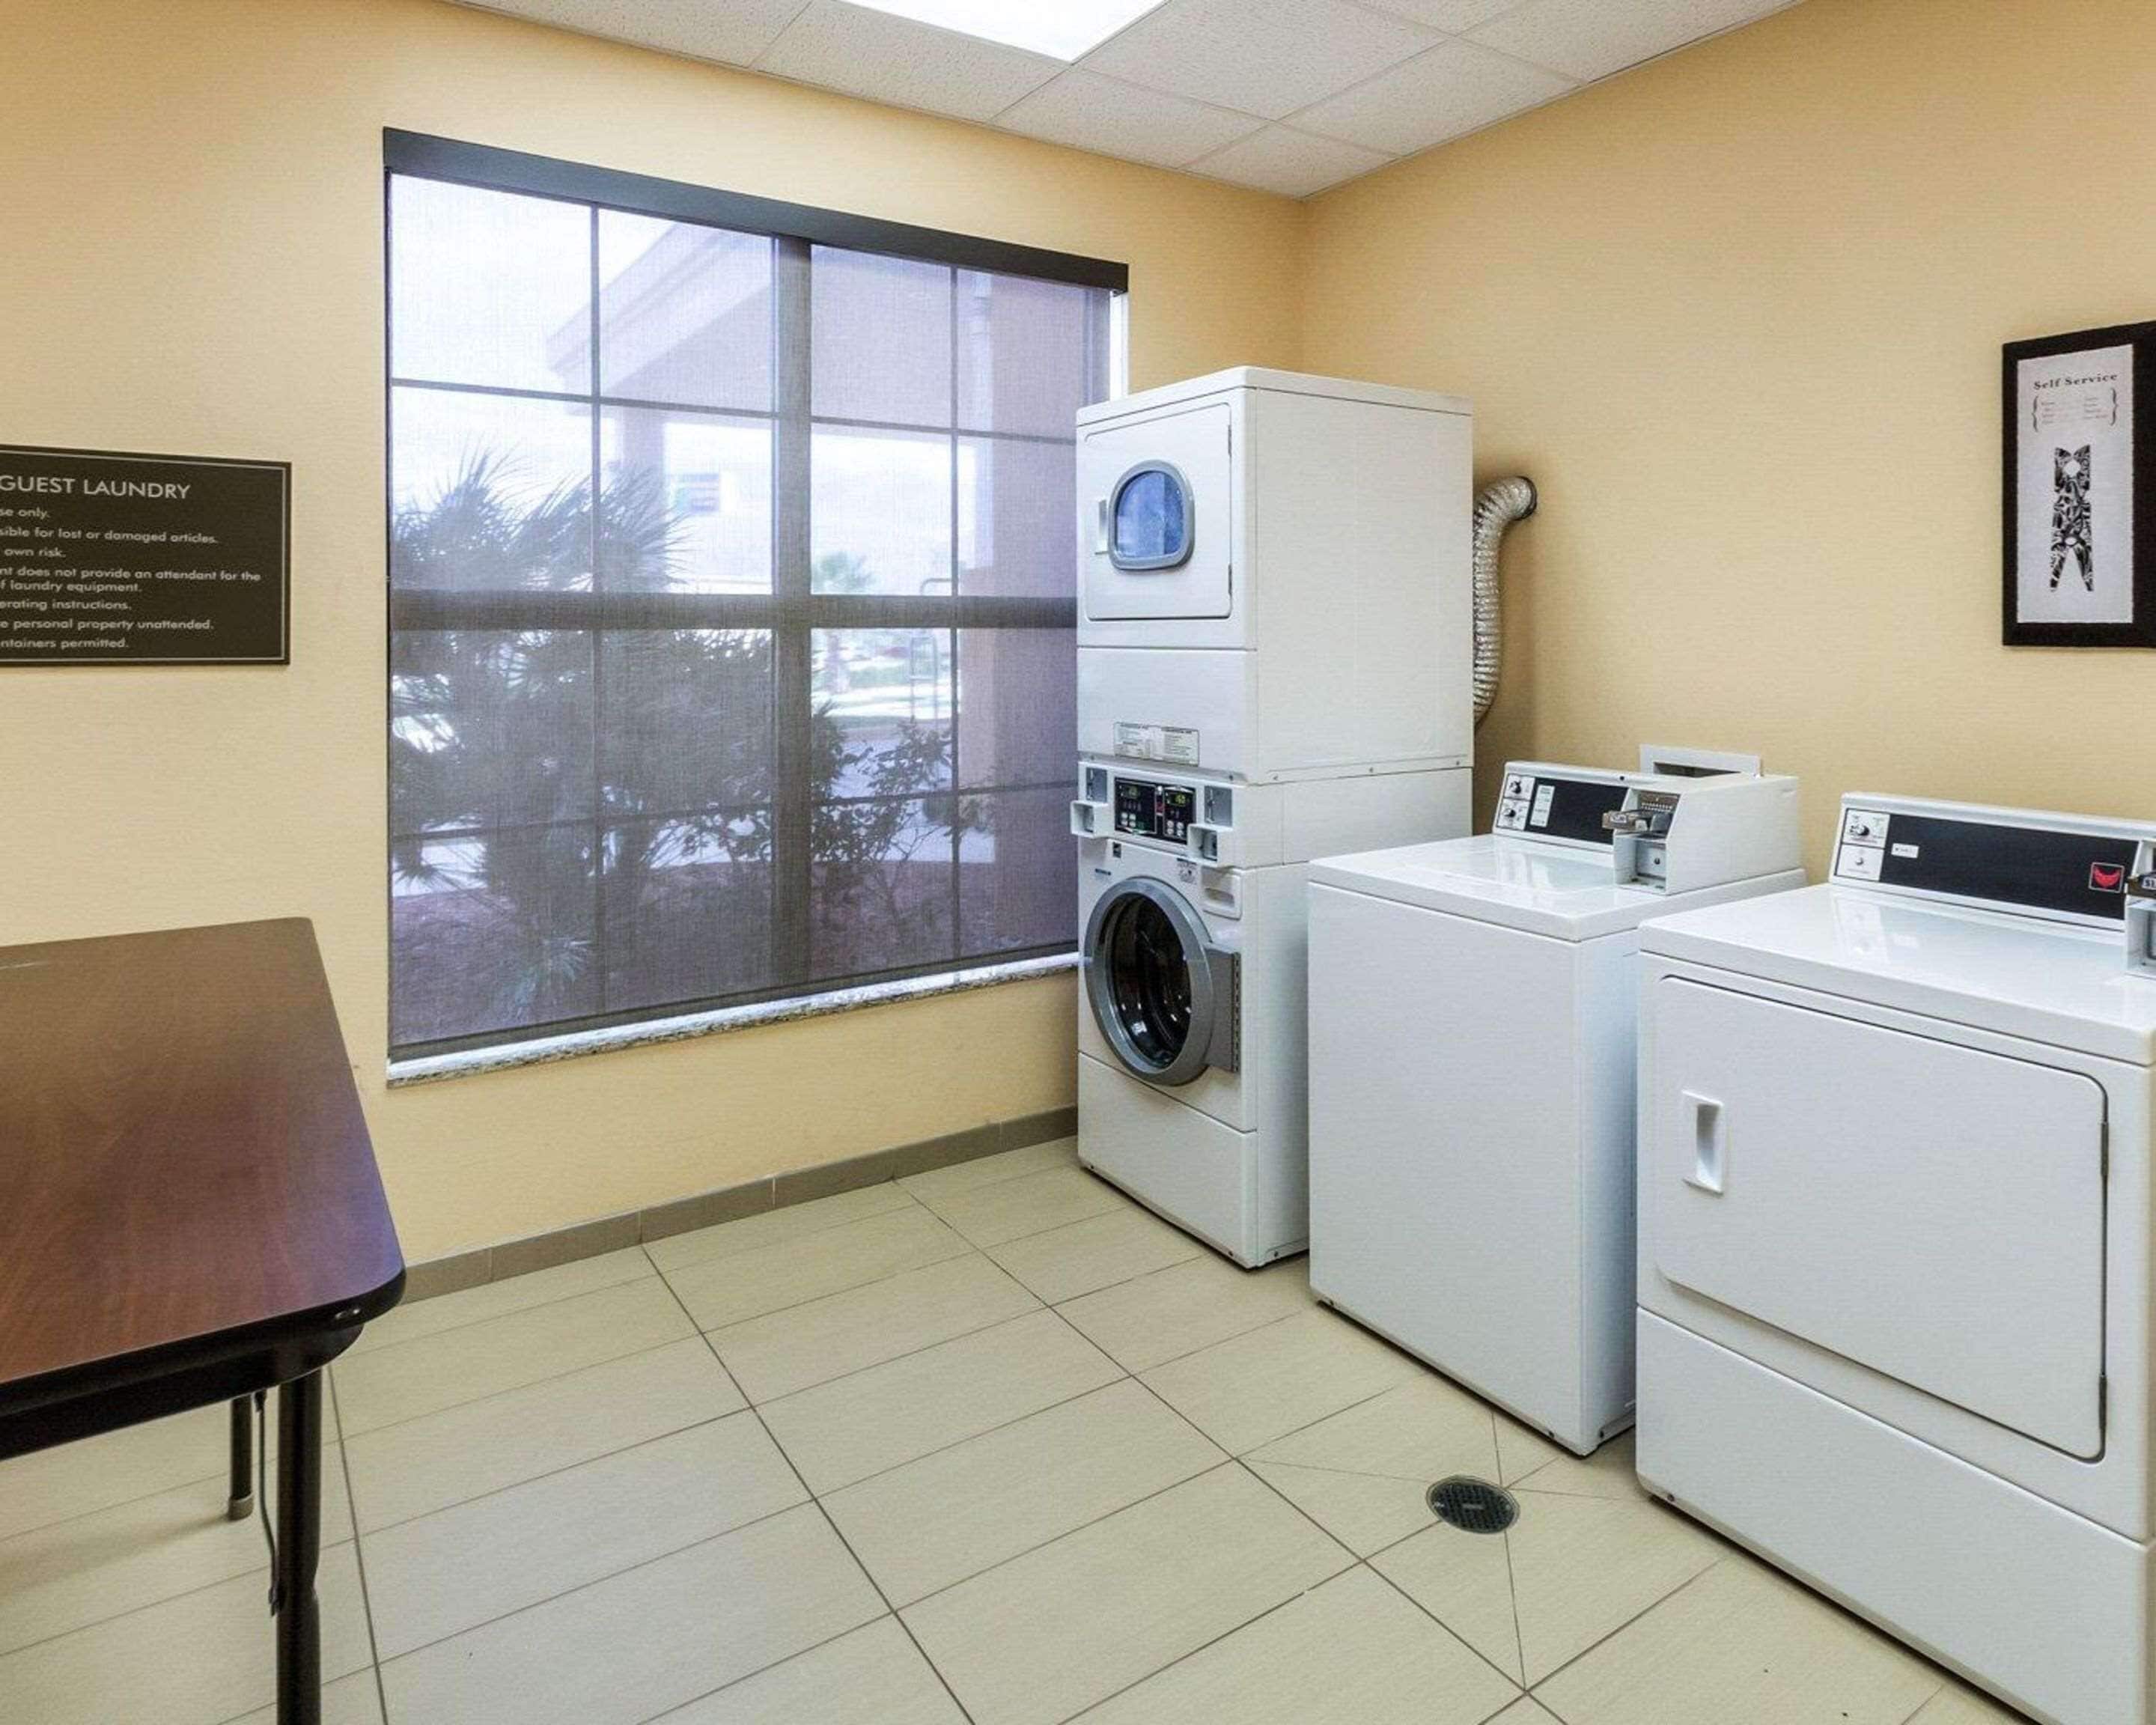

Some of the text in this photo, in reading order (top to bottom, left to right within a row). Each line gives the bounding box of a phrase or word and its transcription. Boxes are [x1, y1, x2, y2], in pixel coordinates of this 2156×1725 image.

[2033, 374, 2118, 390] Self Service
[0, 475, 191, 499] GUEST LAUNDRY
[18, 507, 51, 520] only.
[34, 527, 54, 538] for
[58, 528, 82, 539] lost
[86, 531, 101, 539] or
[104, 530, 166, 544] damaged
[170, 532, 219, 544] articles.
[4, 547, 66, 558] own risk.
[18, 566, 50, 576] does
[55, 568, 76, 577] not
[81, 568, 131, 579] provide
[135, 571, 152, 579] an
[156, 570, 216, 580] attendant
[221, 570, 237, 581] for
[242, 571, 261, 582] the
[10, 579, 62, 592] laundry
[67, 582, 142, 593] equipment.
[52, 599, 133, 610] instructions.
[13, 618, 73, 631] personal
[77, 620, 134, 631] property
[137, 619, 214, 630] unattended.
[61, 637, 129, 650] permitted.
